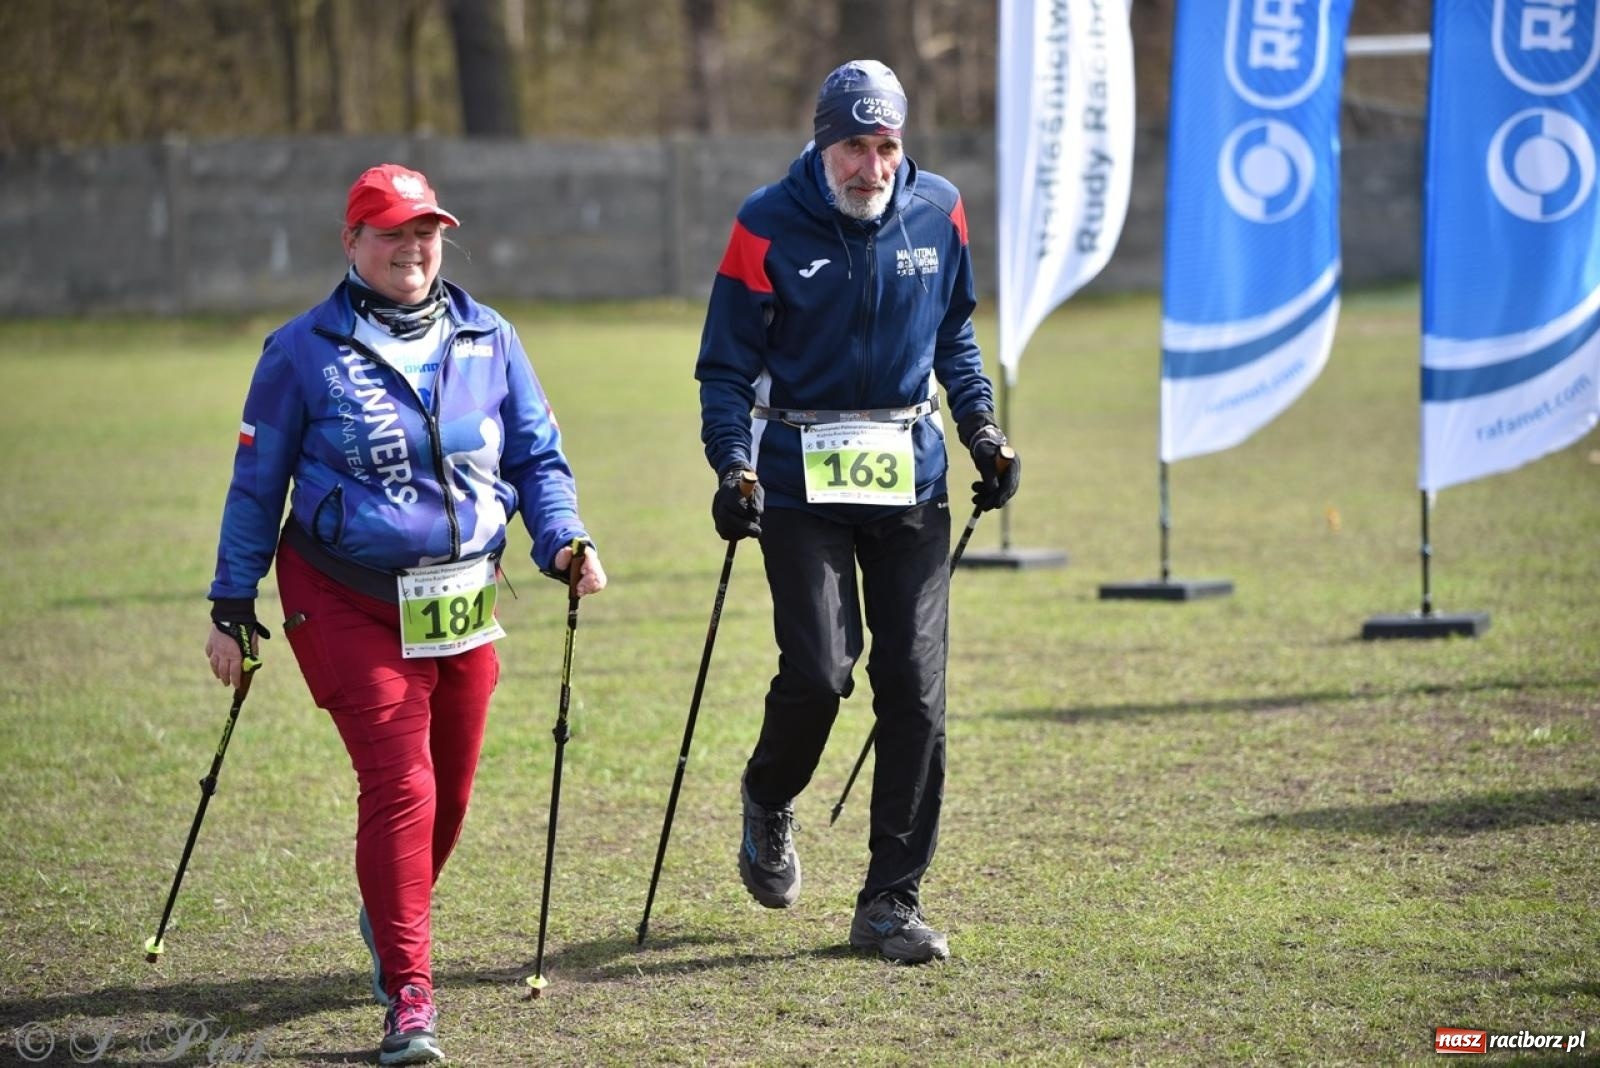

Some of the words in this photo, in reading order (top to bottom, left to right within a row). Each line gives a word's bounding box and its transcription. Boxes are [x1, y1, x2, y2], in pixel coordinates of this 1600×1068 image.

[1519, 0, 1576, 51] R
[1075, 144, 1114, 254] Rudy
[321, 363, 356, 444] EKO-OKNA
[339, 342, 420, 506] RUNNERS
[1476, 374, 1592, 441] rafamet.com
[823, 452, 899, 490] 163
[420, 590, 485, 640] 181
